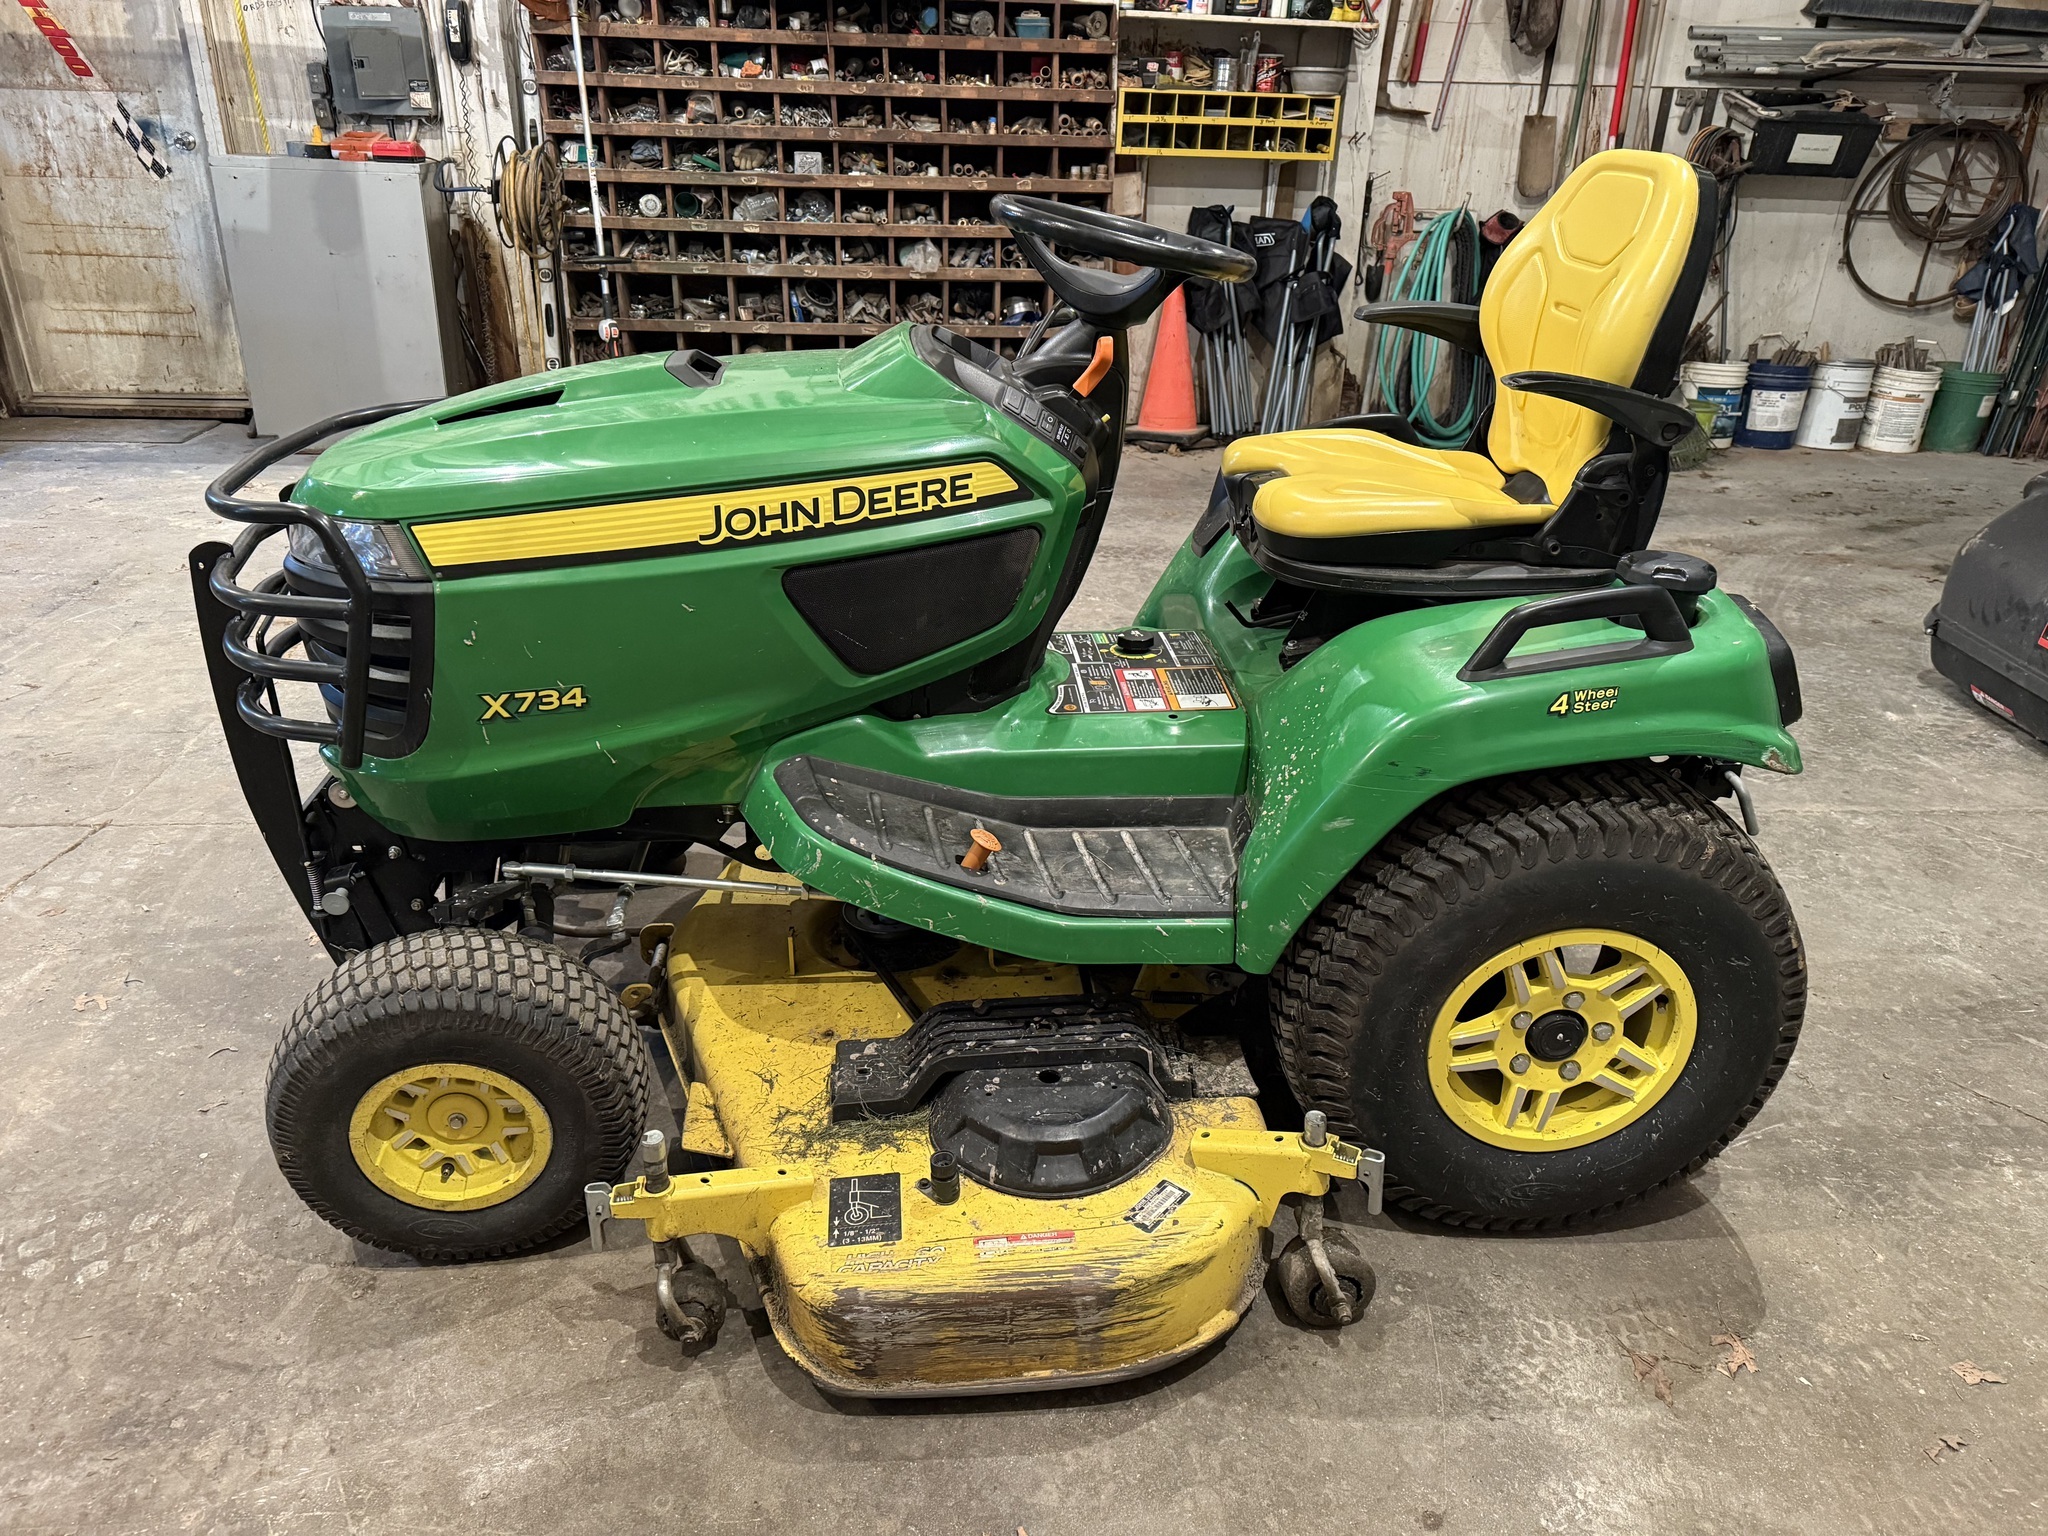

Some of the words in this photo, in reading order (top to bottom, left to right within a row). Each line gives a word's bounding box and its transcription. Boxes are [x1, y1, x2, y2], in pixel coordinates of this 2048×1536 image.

[698, 496, 820, 541] JOHN
[832, 472, 973, 521] DEERE
[480, 687, 587, 720] X734
[1549, 693, 1569, 715] 4
[1574, 687, 1619, 702] Wheel
[1572, 699, 1617, 714] Steer
[857, 1235, 882, 1243] 13MM)
